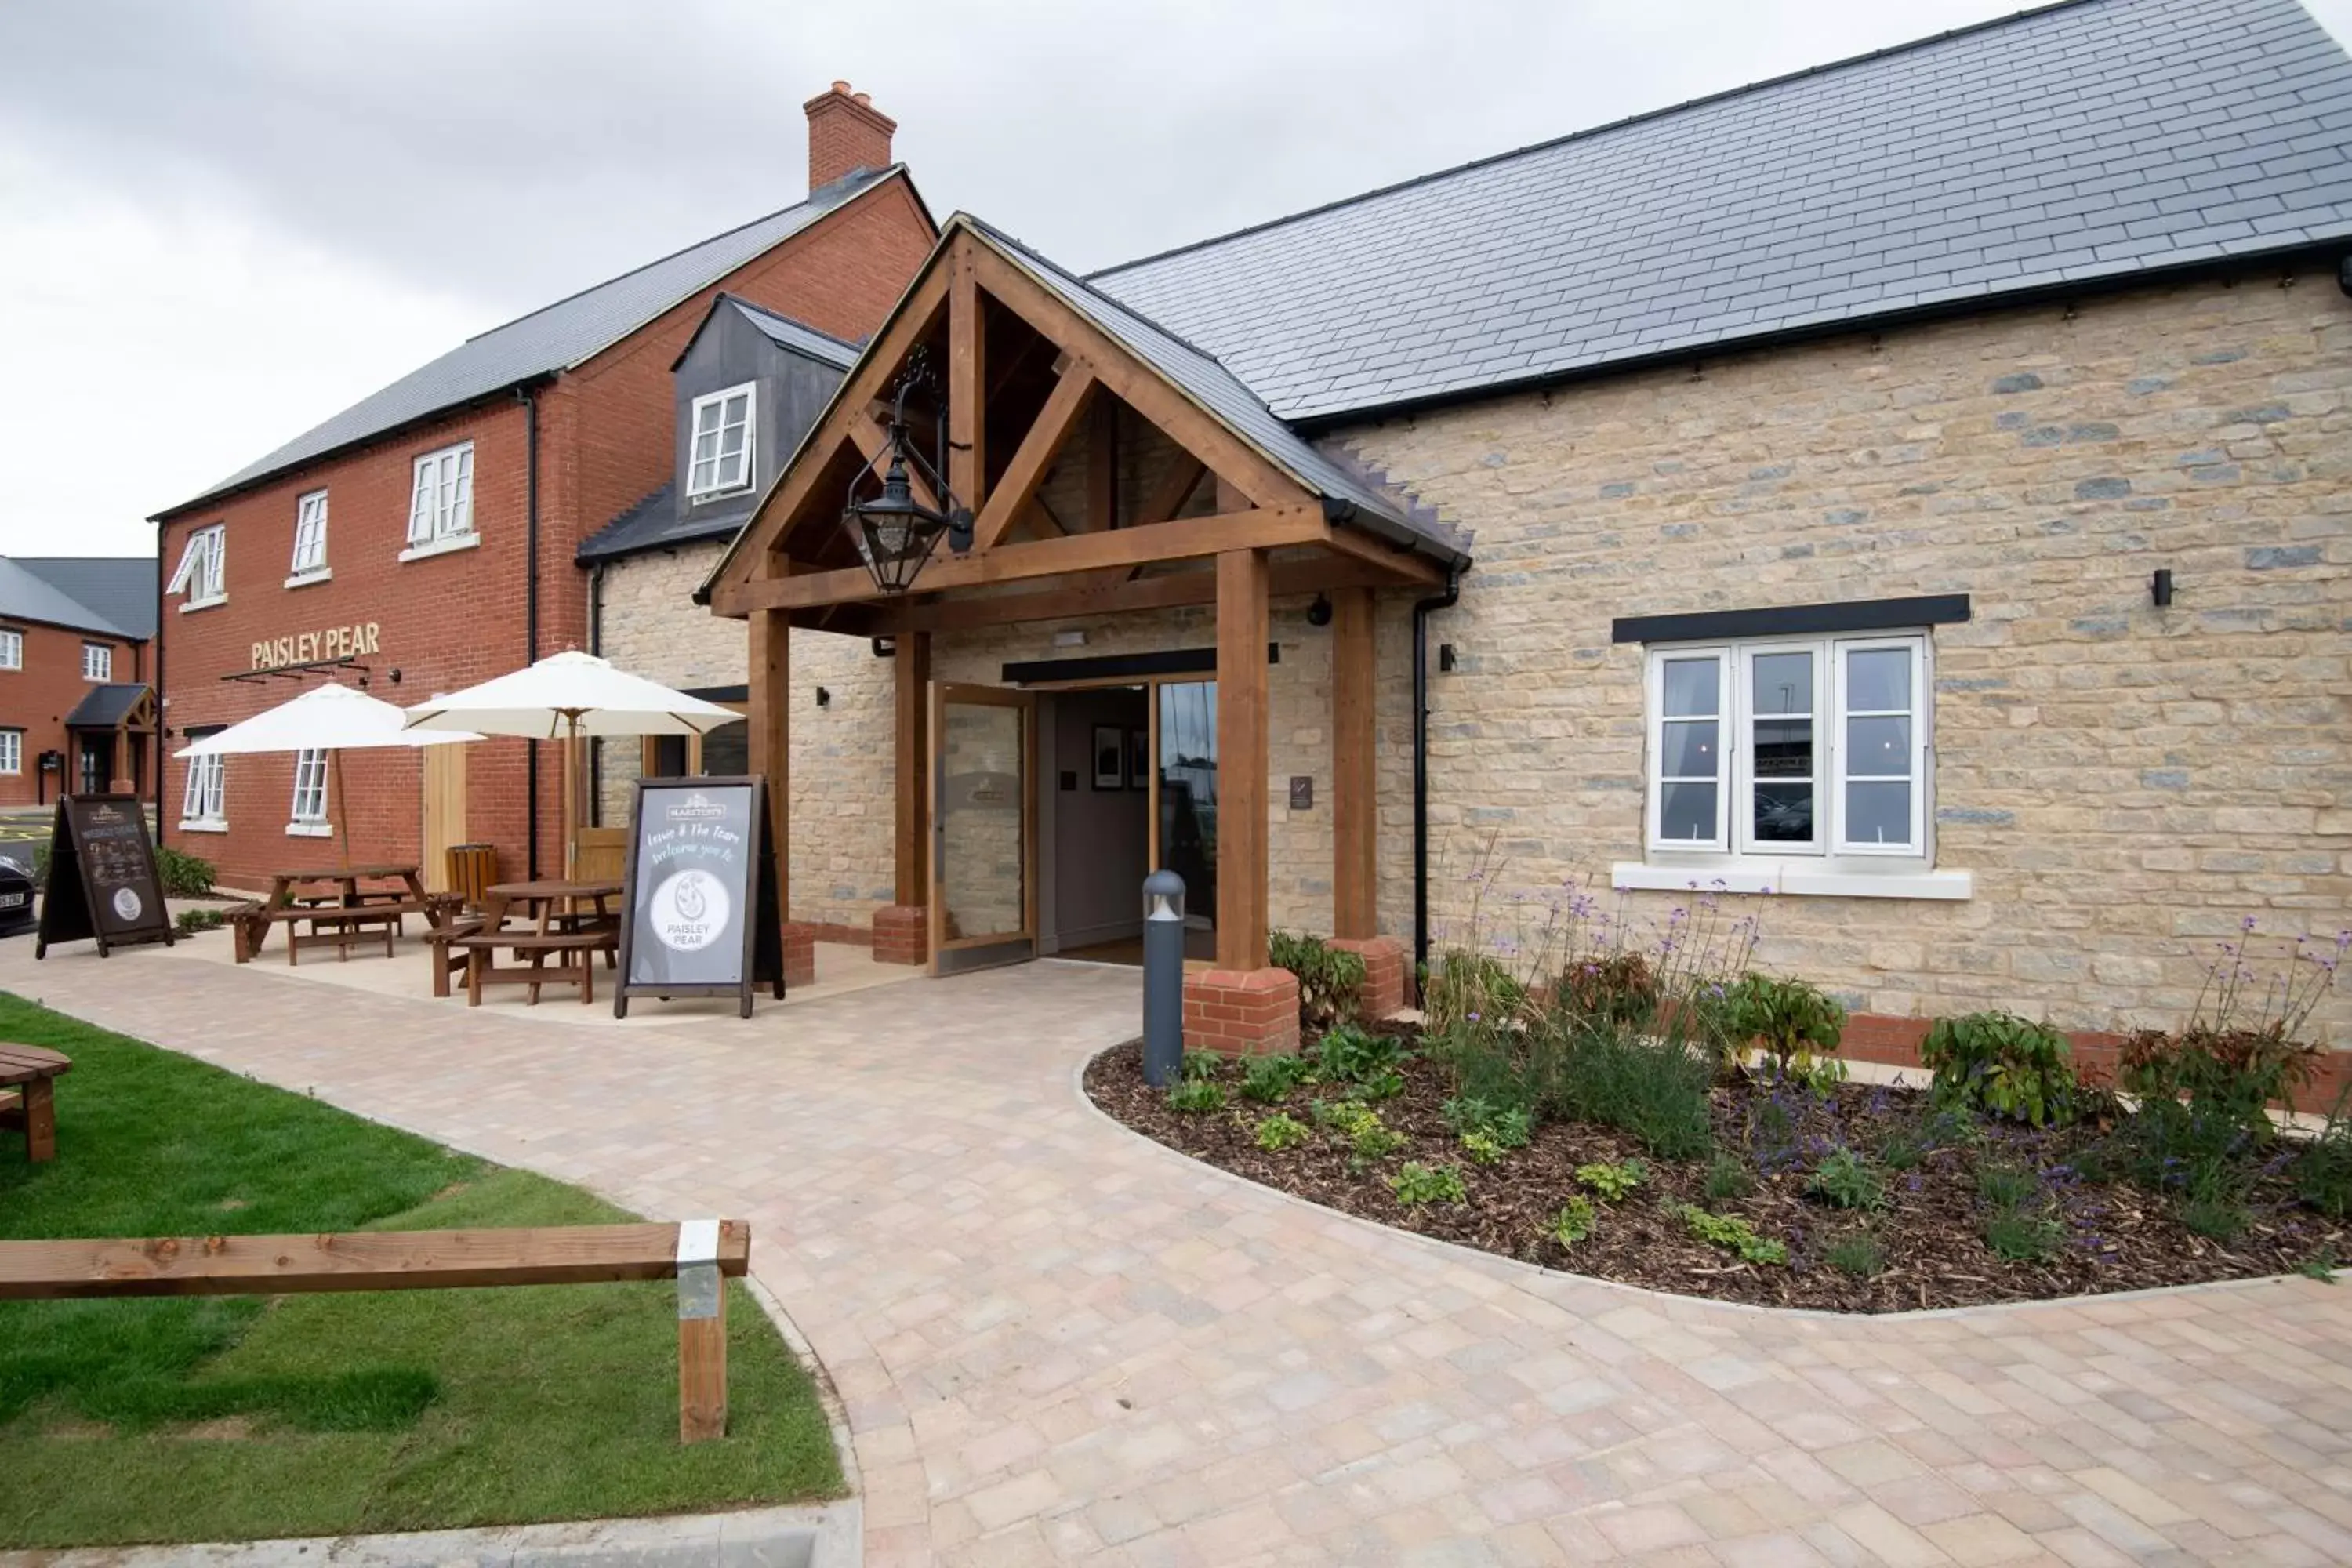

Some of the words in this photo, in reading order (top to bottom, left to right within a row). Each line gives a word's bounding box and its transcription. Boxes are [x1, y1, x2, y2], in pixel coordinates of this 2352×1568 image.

[252, 632, 321, 670] PAISLEY
[326, 622, 379, 659] PEAR
[691, 822, 710, 837] The
[713, 825, 740, 844] Team
[667, 924, 710, 934] PAISLEY
[673, 935, 702, 945] PEAR
